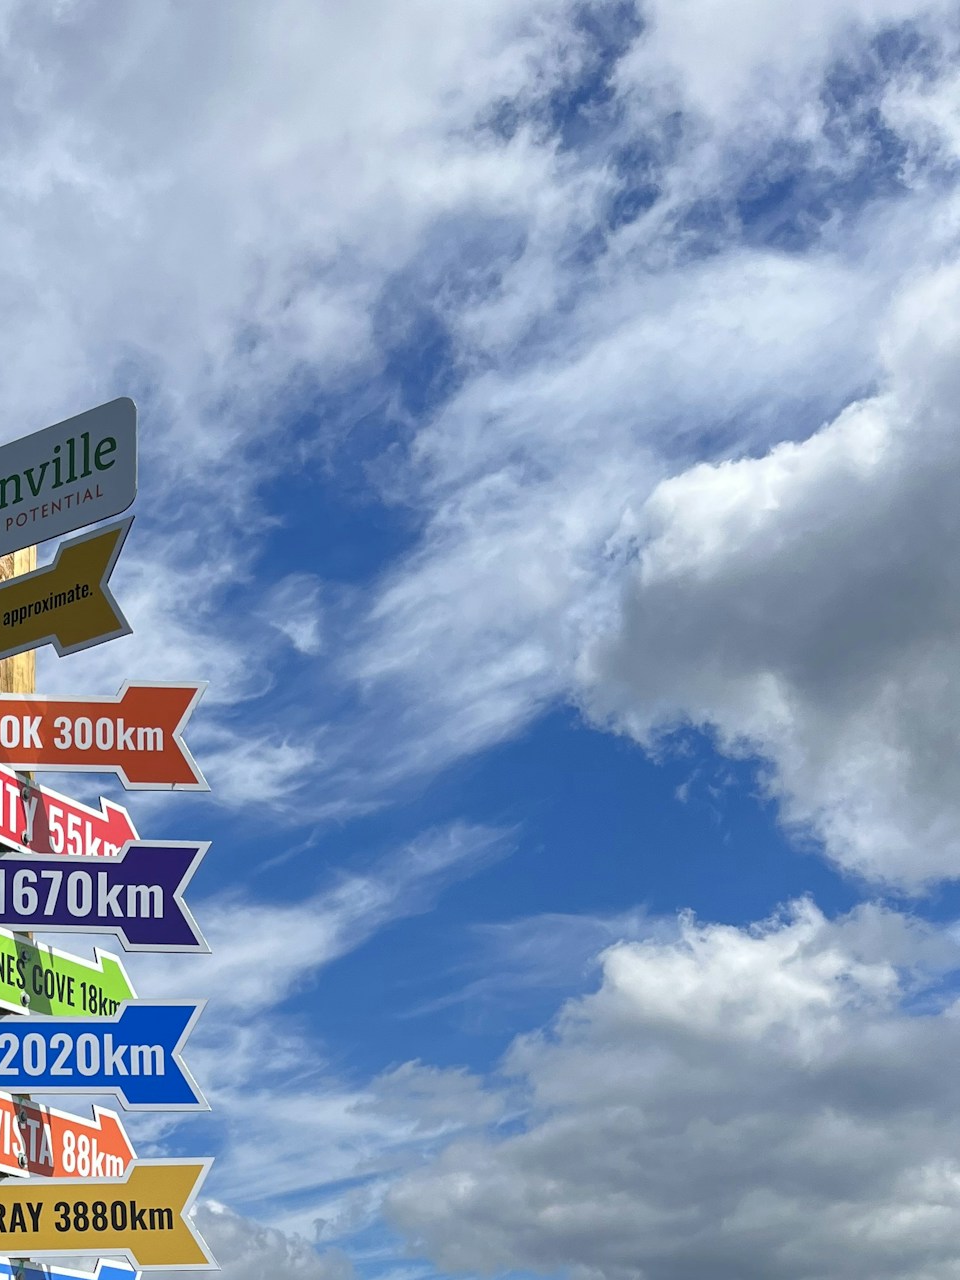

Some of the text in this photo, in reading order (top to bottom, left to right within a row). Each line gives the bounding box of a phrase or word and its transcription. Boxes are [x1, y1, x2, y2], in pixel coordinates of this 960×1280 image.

[6, 483, 104, 532] POTENTIAL
[3, 583, 94, 630] approximate.
[53, 715, 164, 752] 300km
[32, 964, 76, 1008] COVE
[62, 1129, 124, 1177] 88km
[55, 1200, 174, 1231] 3880km
